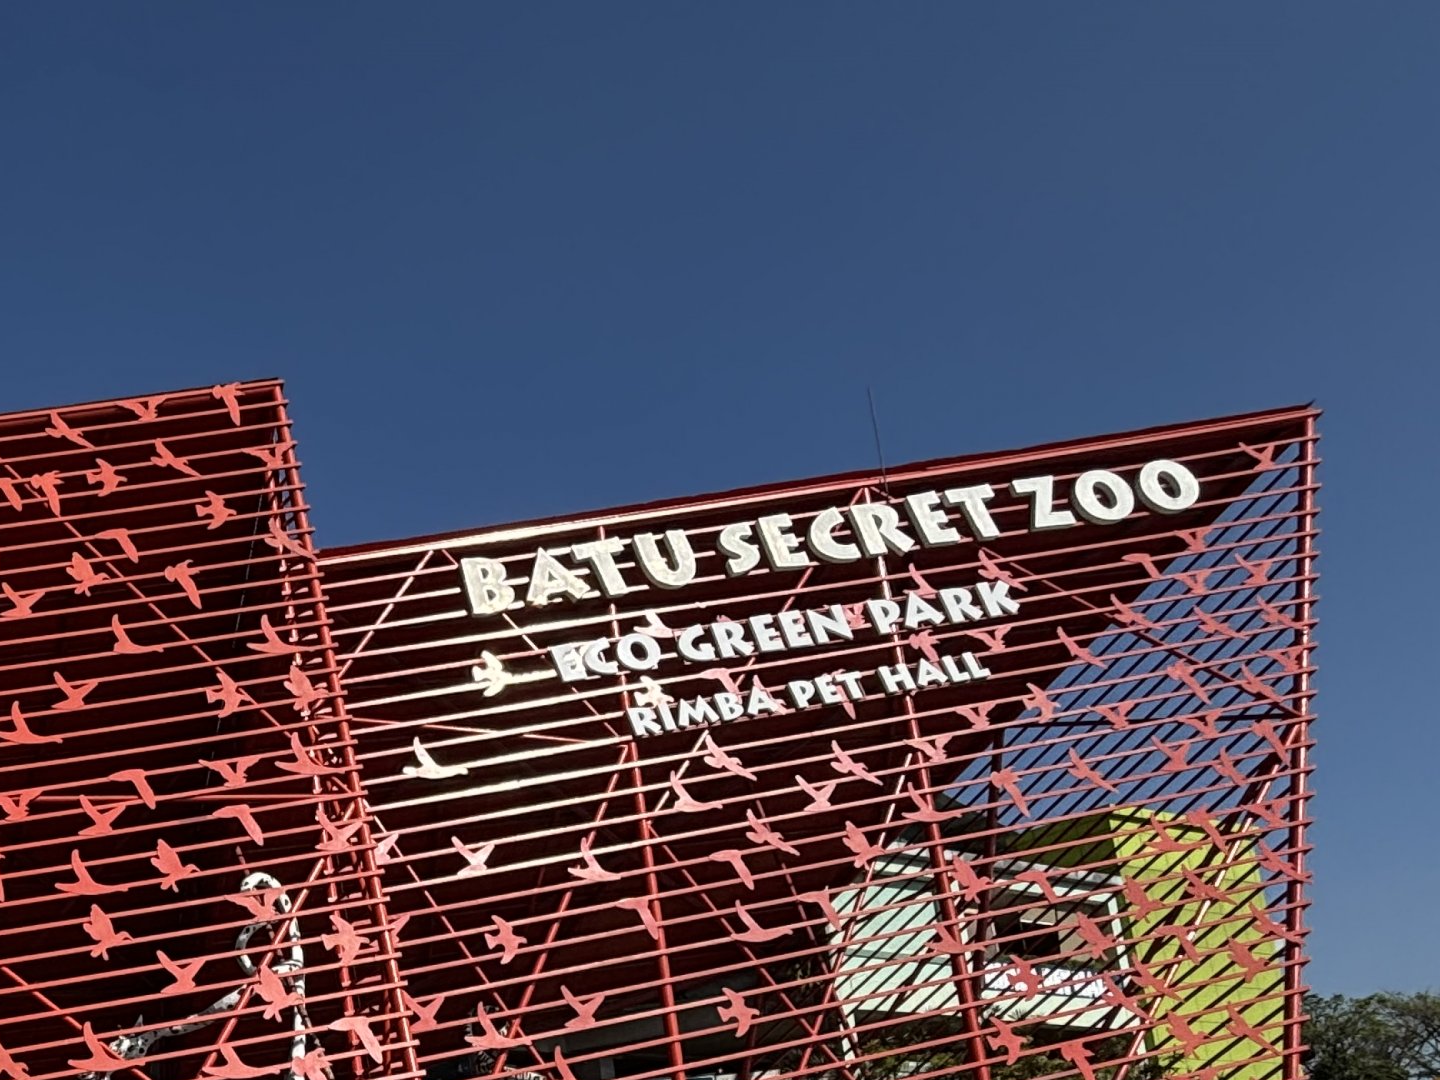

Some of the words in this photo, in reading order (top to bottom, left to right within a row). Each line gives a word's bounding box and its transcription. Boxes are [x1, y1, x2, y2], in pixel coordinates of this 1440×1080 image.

[460, 528, 698, 616] BATU
[717, 483, 1000, 577] SECRET
[1012, 459, 1201, 531] ZOO
[550, 631, 661, 683] ECO
[678, 603, 857, 664] GREEN
[870, 579, 1021, 635] PARK
[628, 684, 778, 738] RIMBA
[789, 670, 866, 713] PET
[884, 651, 991, 696] HALL
